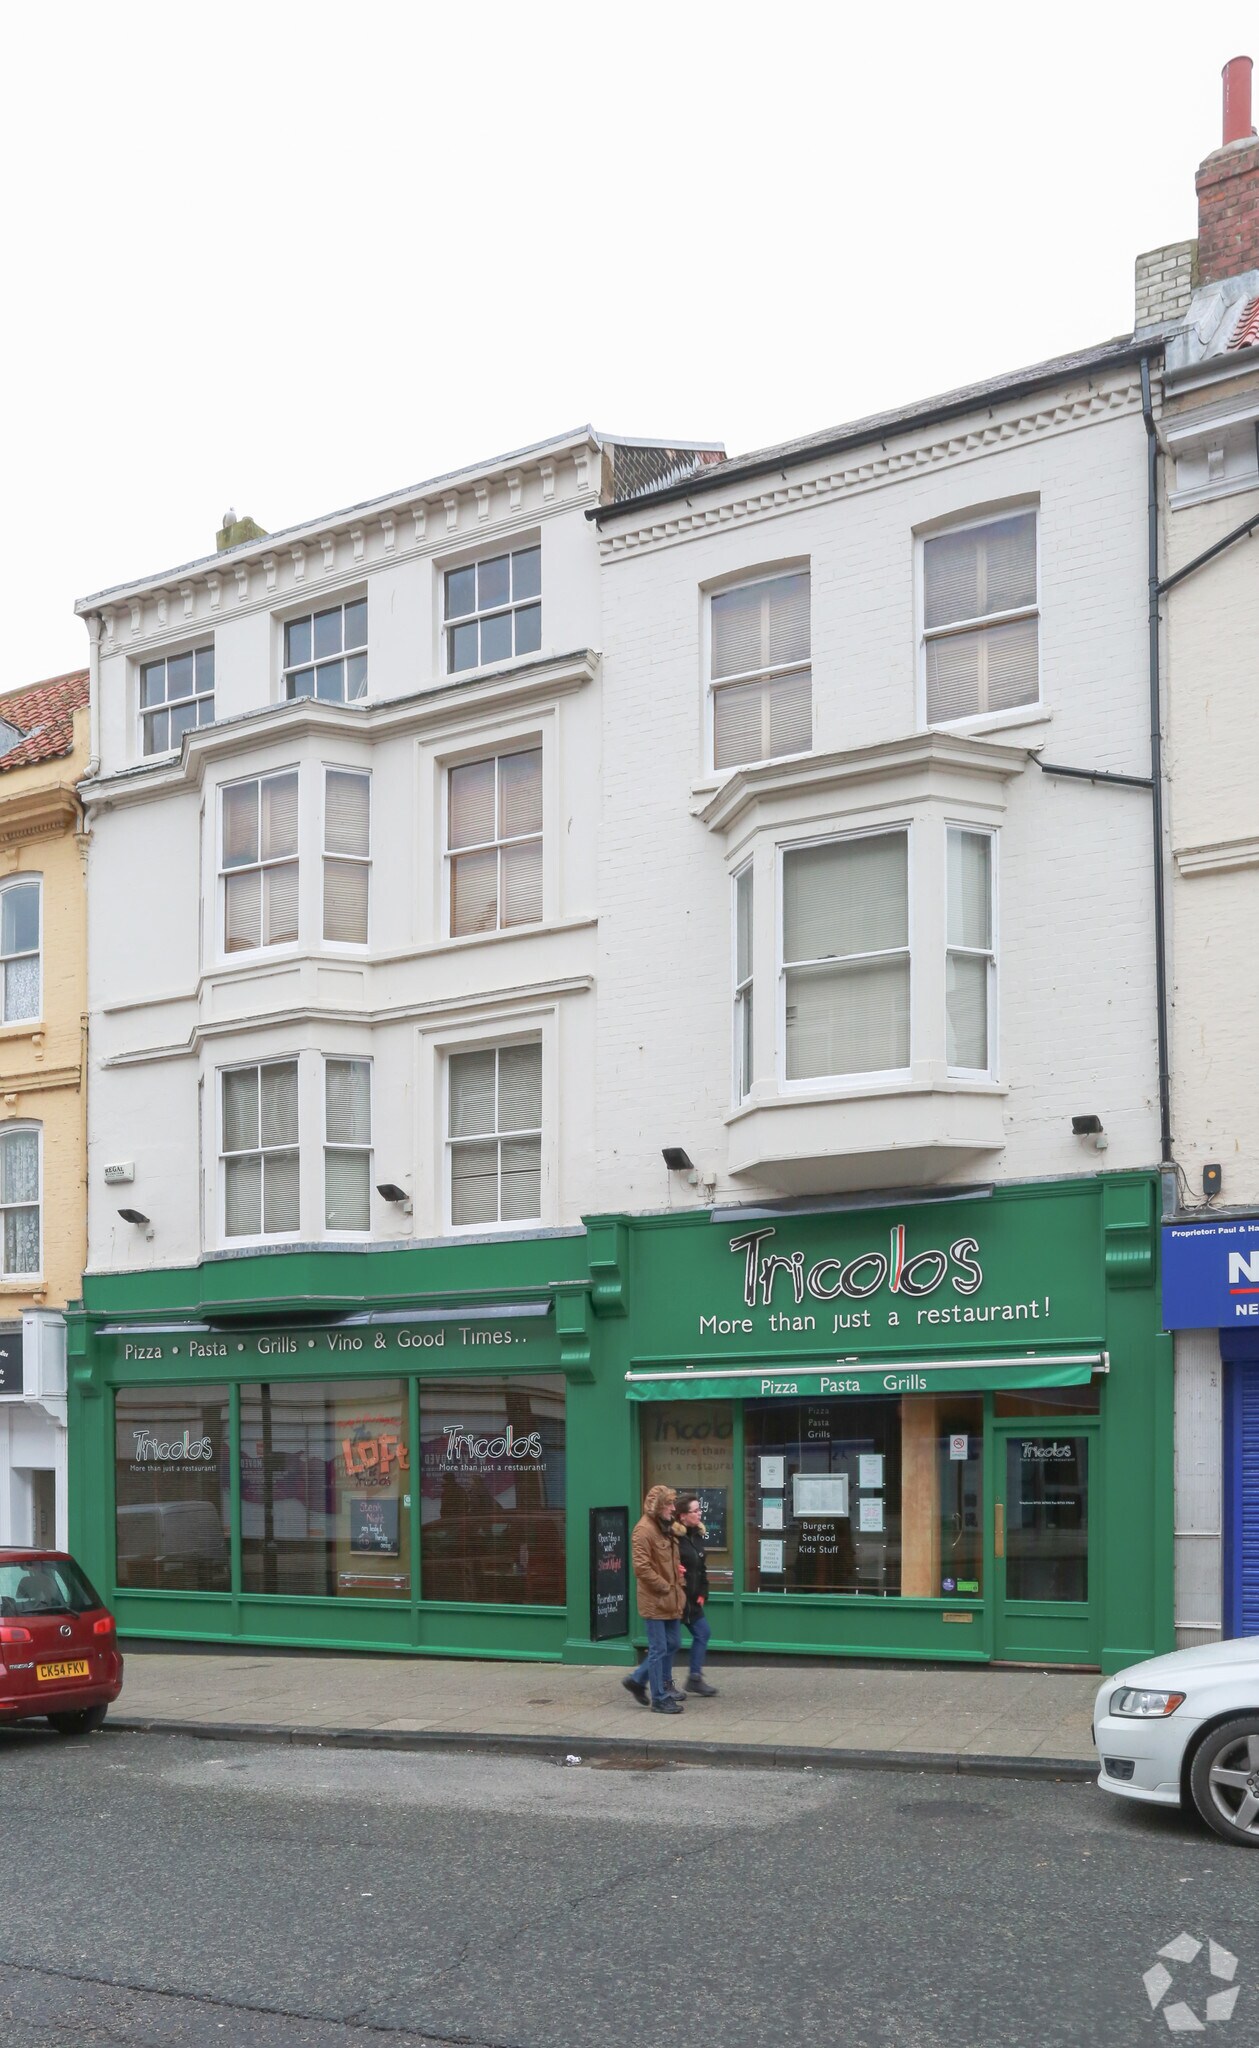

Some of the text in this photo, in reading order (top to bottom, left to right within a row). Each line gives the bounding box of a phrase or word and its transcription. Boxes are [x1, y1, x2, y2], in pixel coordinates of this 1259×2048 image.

[105, 1165, 124, 1173] REGAL
[1171, 1228, 1216, 1238] Proprietor:
[1218, 1226, 1237, 1234] Paul
[1239, 1225, 1246, 1233] &
[730, 1224, 983, 1306] Tricolos
[699, 1296, 1050, 1335] More than just a restaurant!
[125, 1343, 162, 1360] Pizza
[189, 1340, 228, 1357] Pasta
[257, 1336, 297, 1354] Grills
[326, 1333, 363, 1350] Vino
[374, 1332, 387, 1349] &
[397, 1328, 445, 1348] Good
[761, 1374, 927, 1395] Pizza Pasta Grills
[808, 1418, 830, 1426] Pasta
[807, 1430, 831, 1439] Grills
[132, 1429, 213, 1462] Tricolos
[443, 1424, 542, 1460] Tricolos
[671, 1445, 726, 1456] More than
[1021, 1441, 1072, 1458] Tricolos
[130, 1464, 146, 1472] More
[147, 1464, 161, 1472] than
[162, 1464, 175, 1473] just
[439, 1463, 458, 1471] More
[460, 1463, 478, 1471] than
[480, 1463, 494, 1473] just
[504, 1463, 547, 1471] restaurant!
[802, 1521, 835, 1532] Burgers
[802, 1533, 836, 1542] Seafood
[799, 1545, 839, 1554] Kids Stuff
[41, 1661, 86, 1678] CK54 FKV
